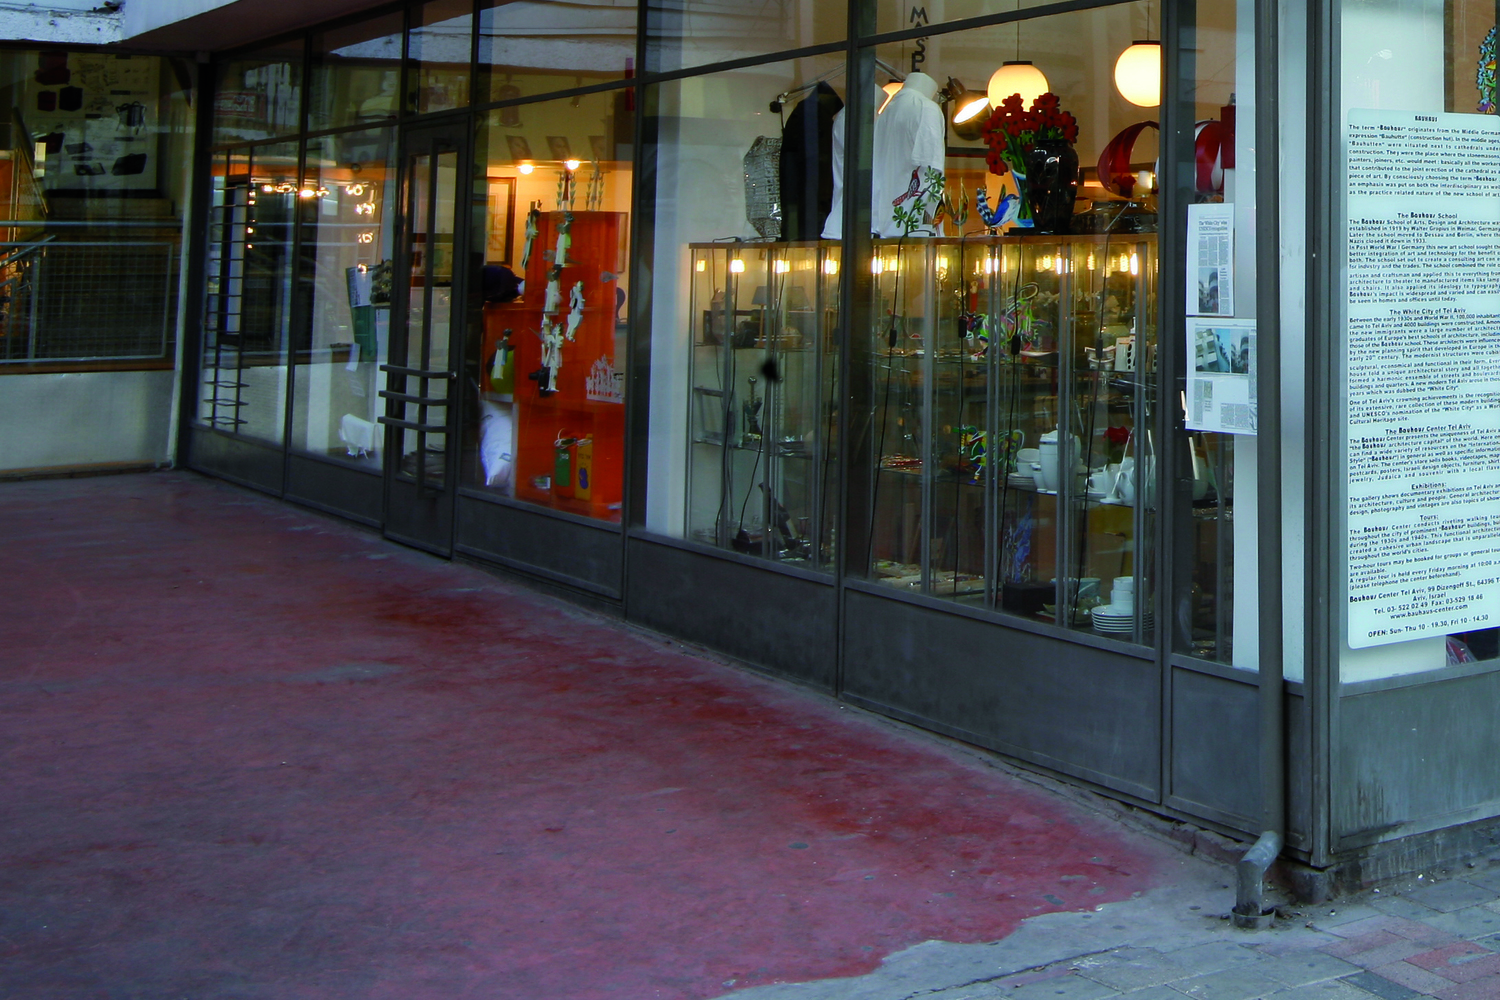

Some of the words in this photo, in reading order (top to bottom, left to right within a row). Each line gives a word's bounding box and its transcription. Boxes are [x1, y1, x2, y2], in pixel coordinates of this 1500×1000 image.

[1398, 425, 1424, 433] Bauhaus
[1419, 513, 1438, 521] Tours:
[1412, 594, 1427, 602] Aviv,
[1390, 603, 1467, 620] www.bauhaus-center.com
